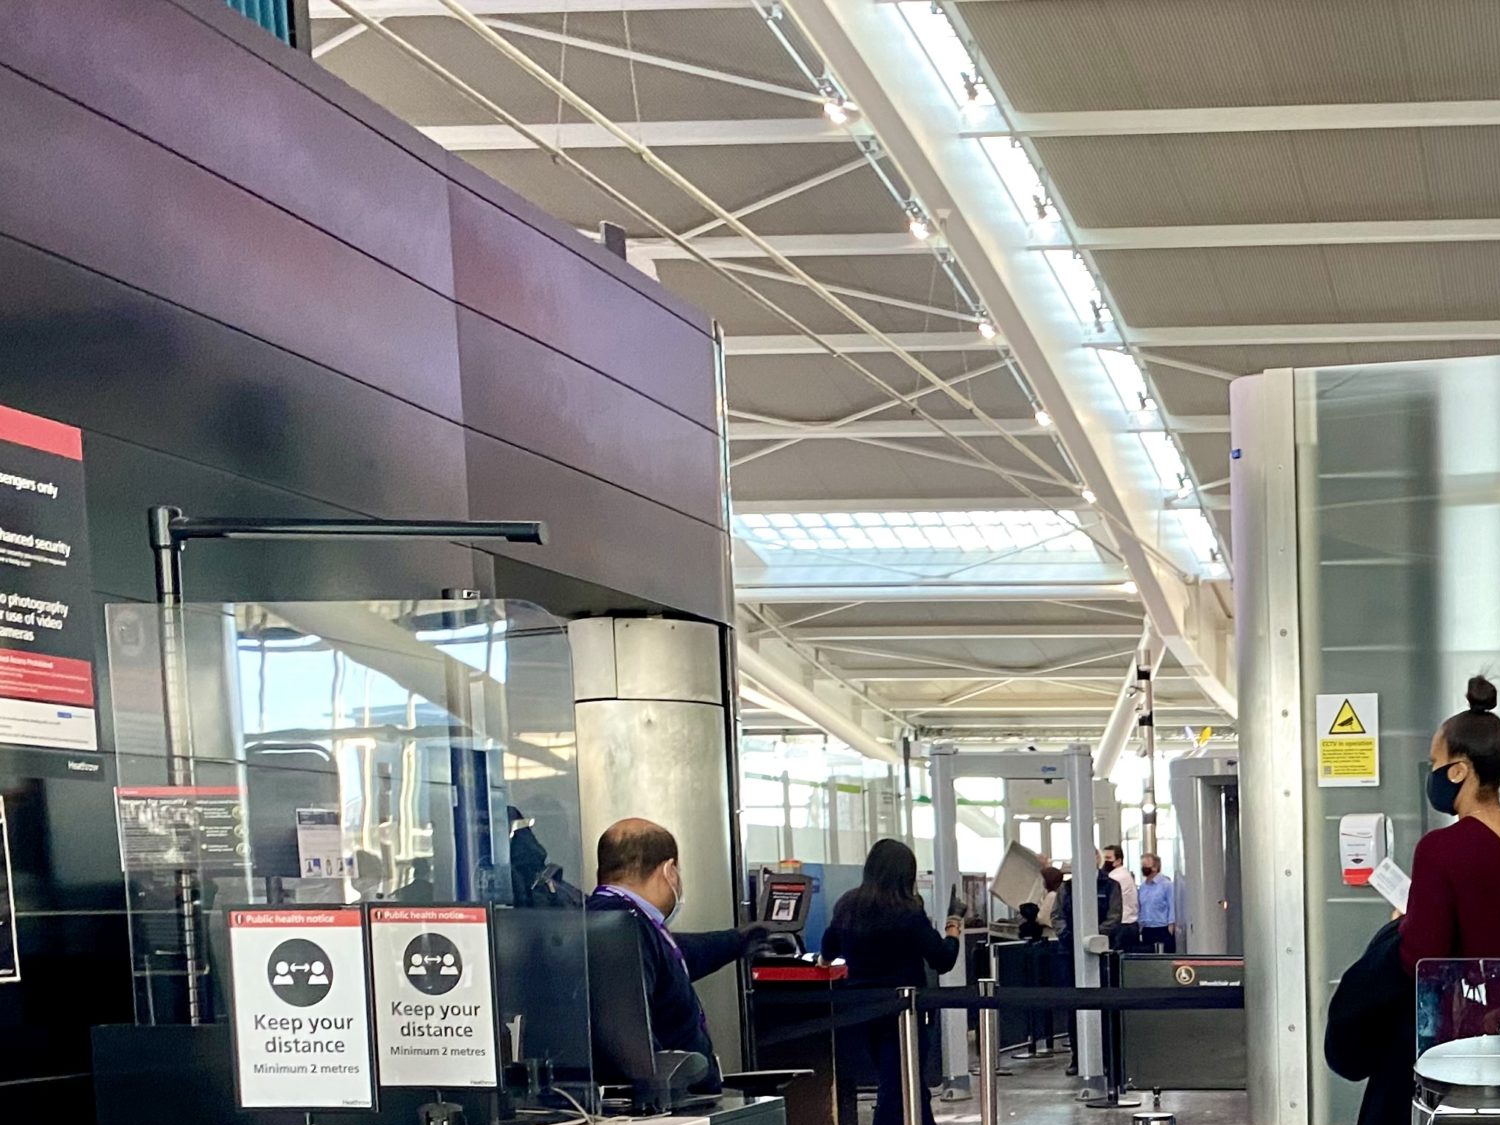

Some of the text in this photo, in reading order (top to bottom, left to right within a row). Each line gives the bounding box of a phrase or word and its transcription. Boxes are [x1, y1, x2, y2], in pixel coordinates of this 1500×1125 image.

[37, 482, 59, 499] only
[35, 538, 71, 558] security
[8, 592, 69, 618] photography
[5, 610, 23, 624] use
[24, 612, 36, 625] of
[36, 614, 63, 630] video
[246, 914, 335, 924] Public health notice
[384, 910, 464, 920] Public health notice
[391, 1001, 481, 1020] Keep your
[254, 1014, 354, 1035] Keep your
[400, 1021, 473, 1037] distance
[265, 1036, 345, 1053] distance
[390, 1046, 486, 1057] Minimum 2 metres
[253, 1063, 360, 1074] Minimum 2 metres
